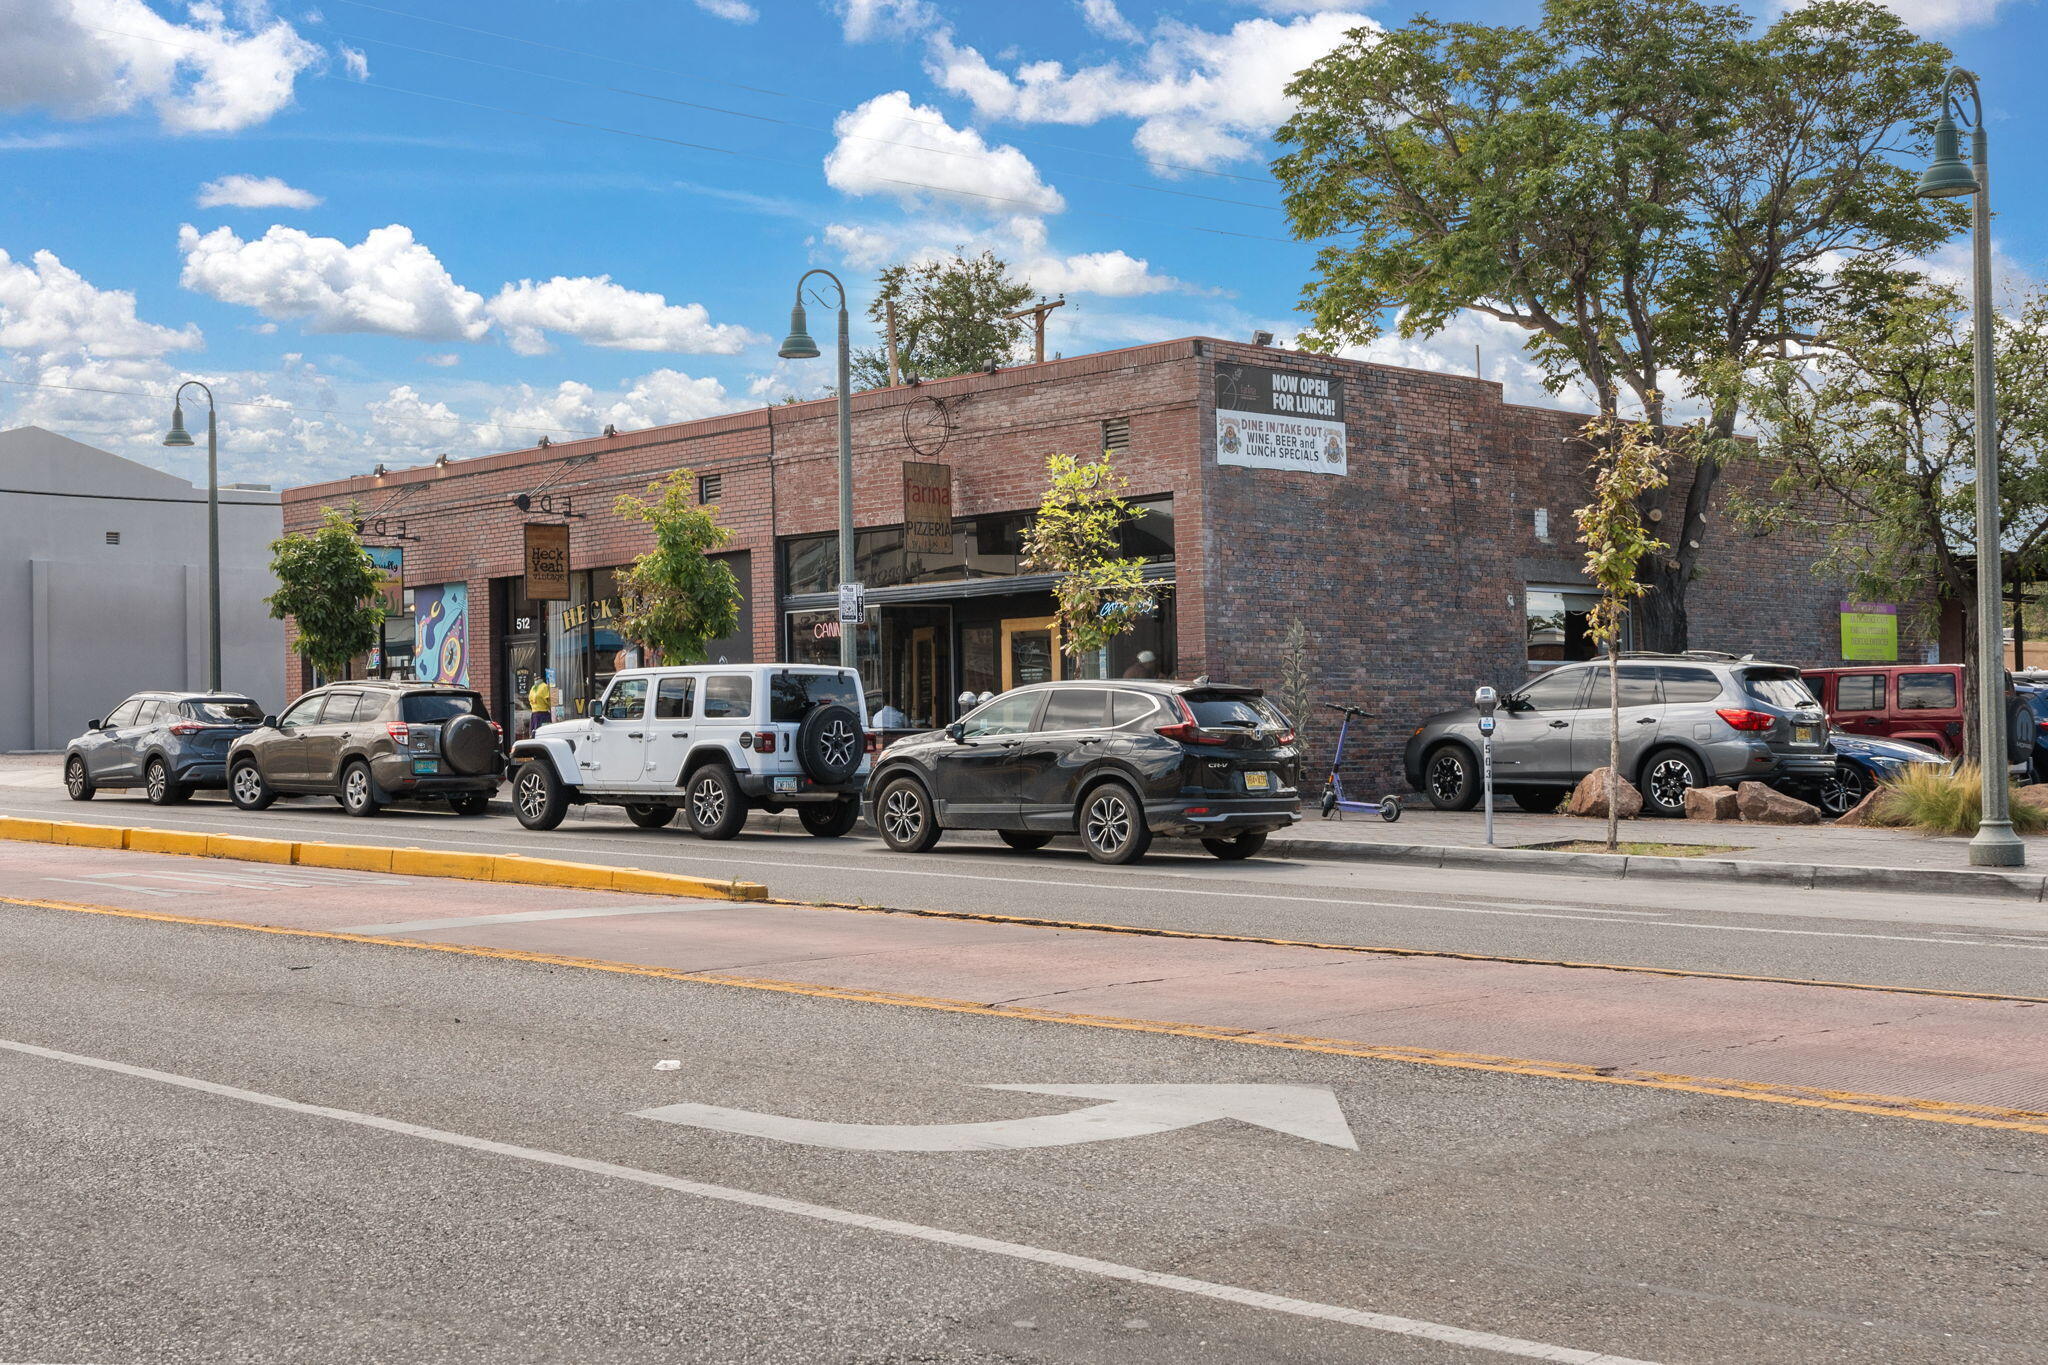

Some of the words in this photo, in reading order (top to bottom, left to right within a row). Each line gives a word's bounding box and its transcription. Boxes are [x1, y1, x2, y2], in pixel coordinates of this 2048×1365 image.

[1272, 374, 1297, 393] NOW
[1300, 378, 1329, 397] OPEN
[1273, 393, 1295, 411] FOR
[1297, 395, 1336, 416] LUNCH!
[1241, 419, 1264, 432] DINE
[1266, 421, 1302, 436] IN/TAKE
[1305, 425, 1323, 438] OUT
[1247, 432, 1273, 446] WINE,
[1275, 434, 1297, 447] BEER
[1299, 439, 1315, 450] and
[1246, 445, 1276, 458] LUNCH
[1279, 448, 1319, 462] SPECIALS
[905, 478, 951, 506] farina
[906, 521, 953, 537] PIZZERIA
[531, 547, 564, 560] Heck
[531, 560, 564, 573] Yeah
[532, 573, 565, 584] vintage
[516, 617, 530, 630] 512
[562, 598, 613, 632] HECK
